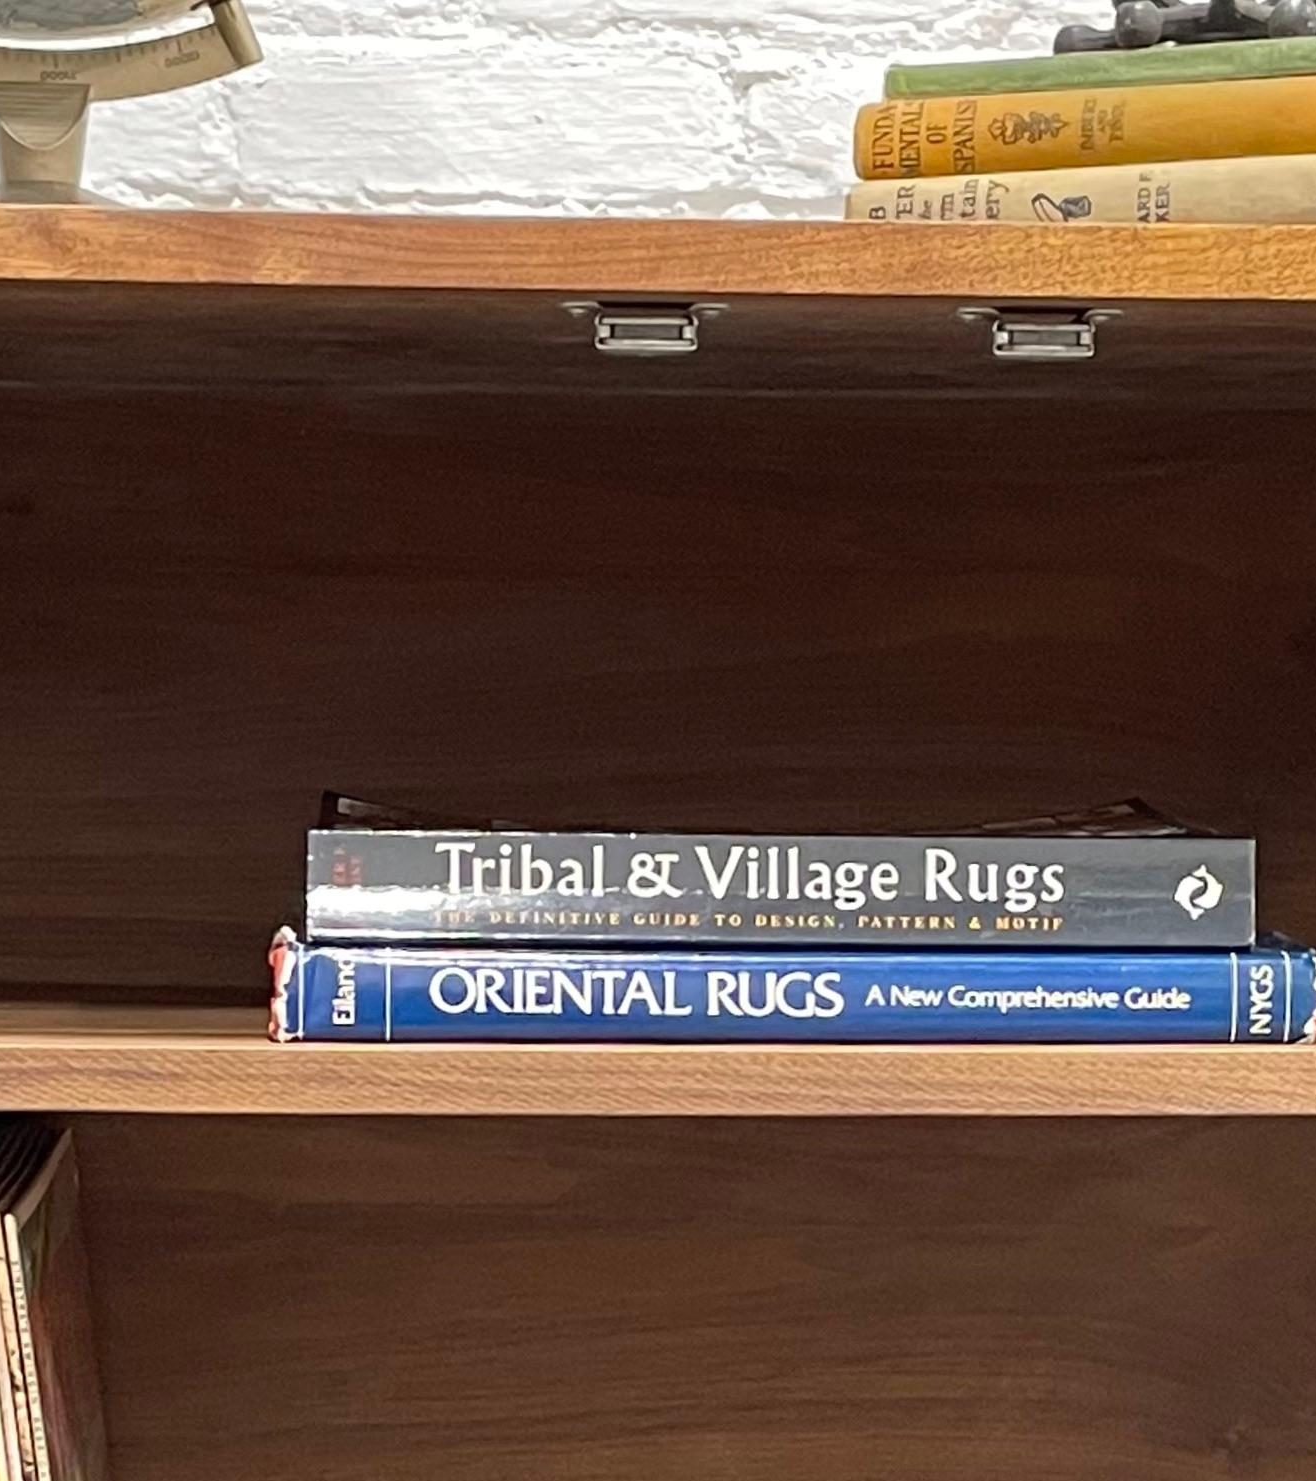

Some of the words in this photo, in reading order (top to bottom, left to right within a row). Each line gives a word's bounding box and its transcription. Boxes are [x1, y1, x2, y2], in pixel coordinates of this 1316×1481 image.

[926, 124, 947, 144] OF
[1155, 181, 1171, 223] KER
[435, 842, 605, 897] Tribal
[628, 852, 683, 898] &
[694, 845, 899, 911] Village
[925, 848, 1065, 912] Rugs
[489, 911, 620, 926] DEFINITIVE
[633, 913, 700, 927] GUIDE
[714, 914, 743, 927] TO
[857, 915, 957, 929] PATTERN
[969, 916, 982, 930] &
[996, 916, 1065, 931] MOTIF
[429, 967, 692, 1014] ORIENTAL
[707, 971, 845, 1017] RUGS
[865, 984, 885, 1007] A
[890, 985, 943, 1007] New
[947, 985, 1120, 1014] Comprehensive
[1124, 986, 1191, 1010] Guide
[1249, 964, 1274, 1035] NYGS
